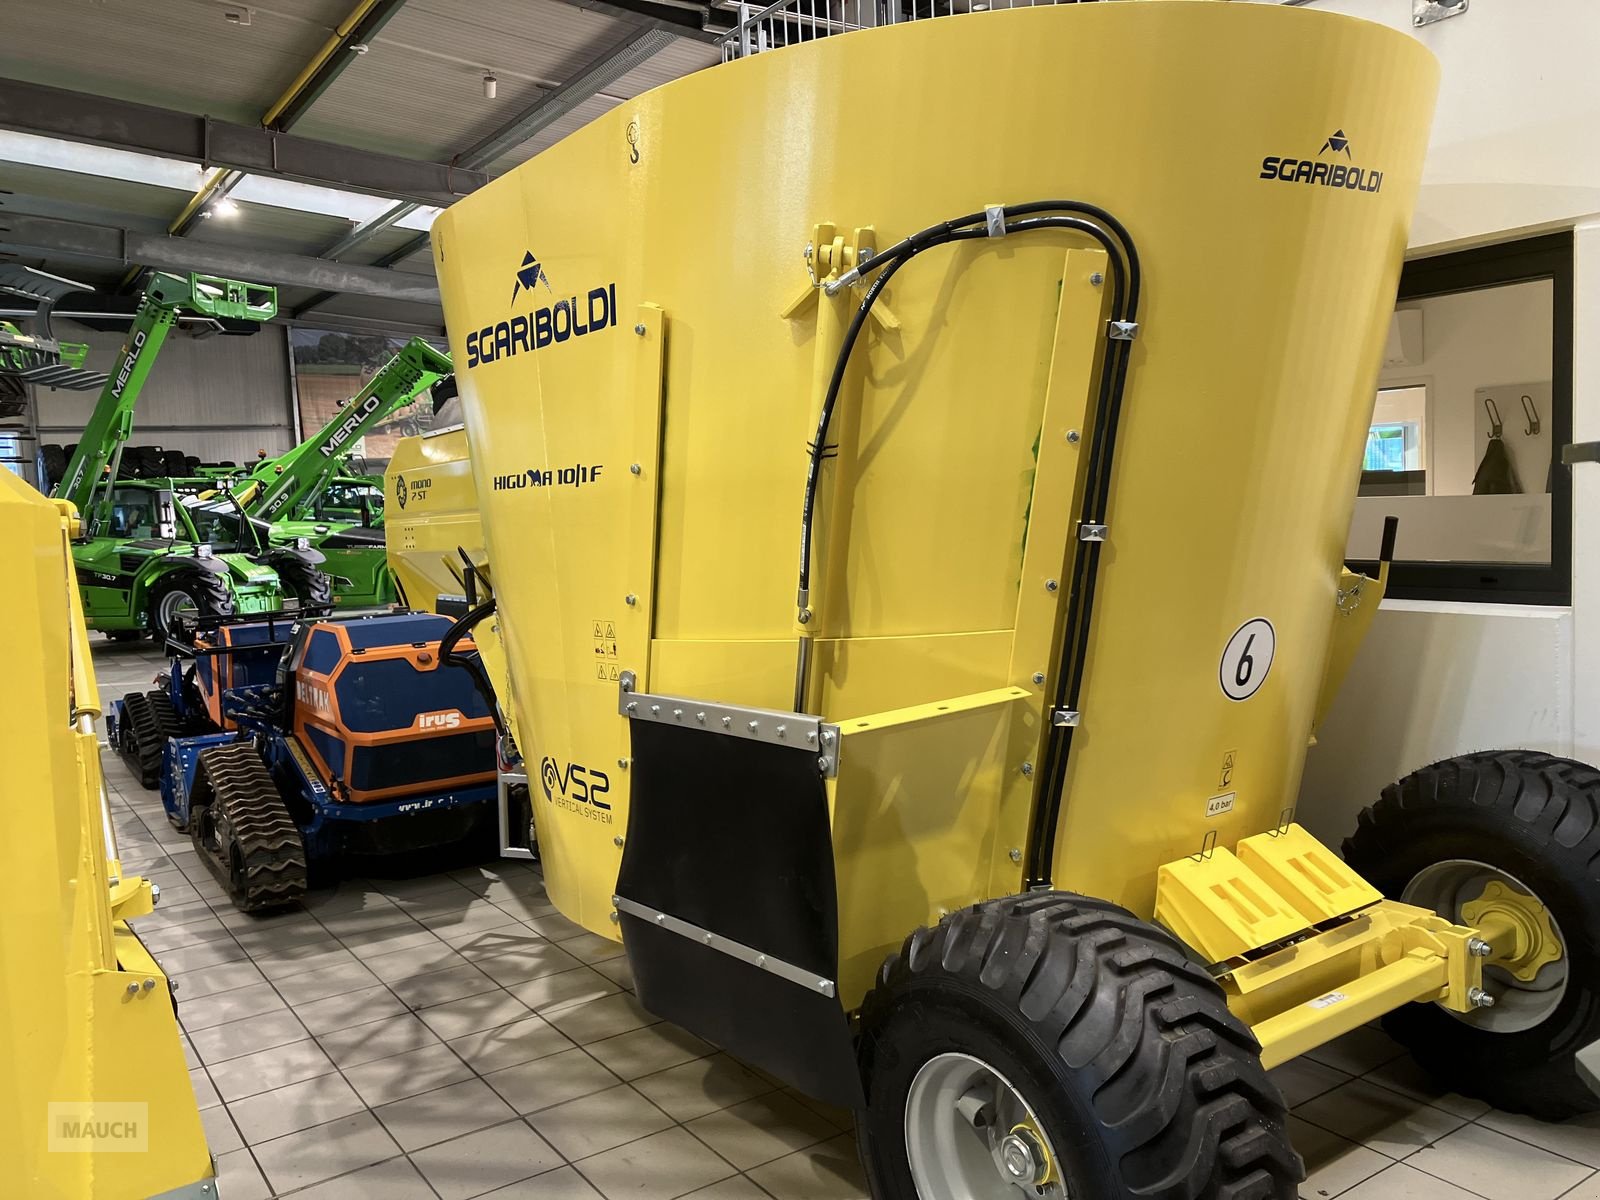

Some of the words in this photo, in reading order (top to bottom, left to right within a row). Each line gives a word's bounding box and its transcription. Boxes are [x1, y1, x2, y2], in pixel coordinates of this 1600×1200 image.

[1259, 156, 1384, 193] SGARIBOLDI
[466, 283, 617, 369] SGARIBOLDI
[111, 330, 146, 398] MERLO
[320, 396, 380, 457] MERLO
[269, 492, 289, 514] 30.9
[1235, 633, 1256, 687] 6
[554, 797, 584, 816] VERTICAL
[584, 807, 613, 825] SYSTEM
